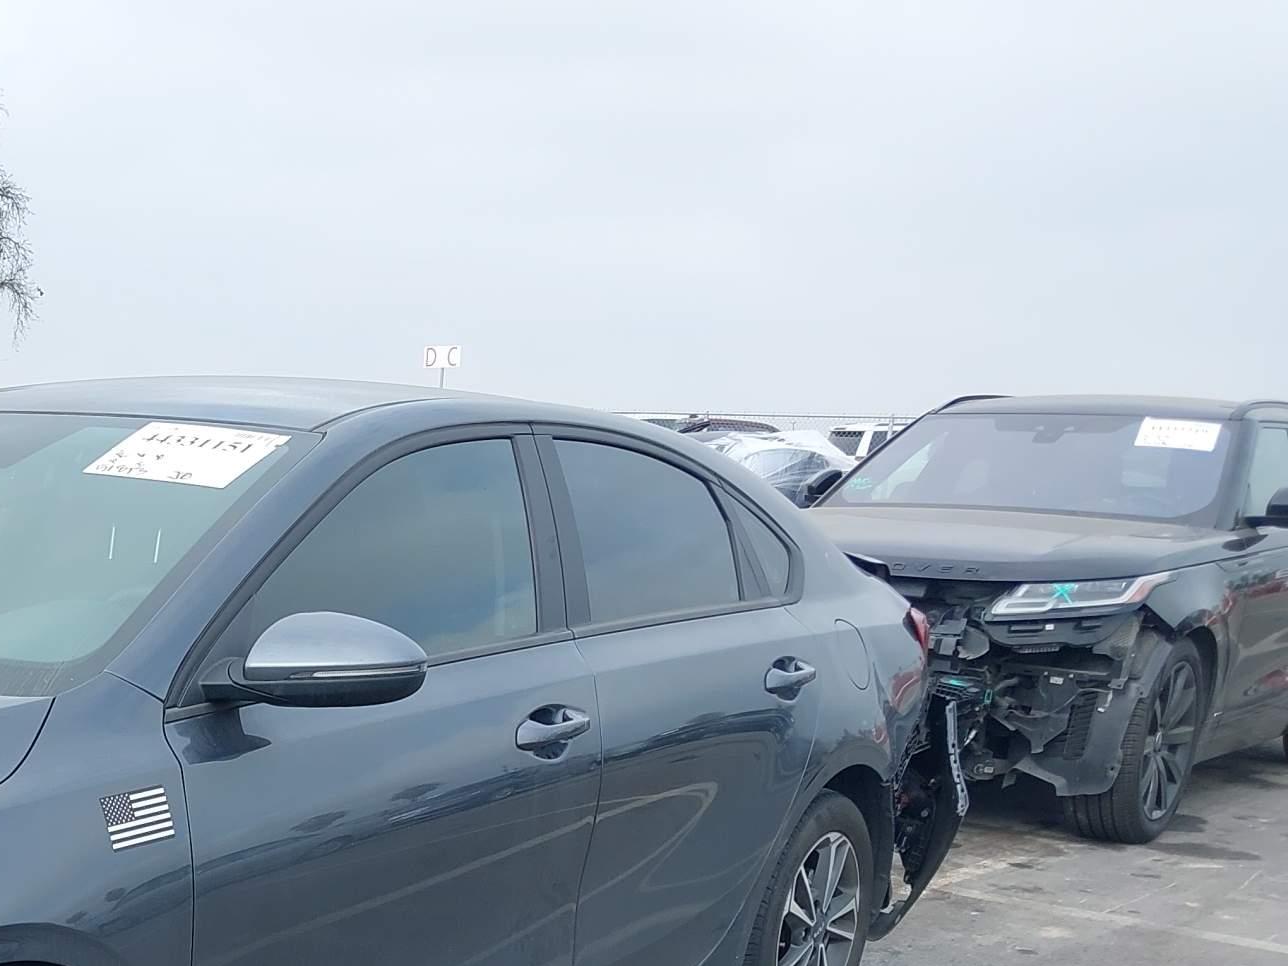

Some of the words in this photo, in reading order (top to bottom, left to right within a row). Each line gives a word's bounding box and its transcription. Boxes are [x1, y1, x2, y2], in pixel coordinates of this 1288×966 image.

[425, 347, 437, 367] D
[447, 346, 458, 367] C
[142, 432, 254, 454] 44331151
[891, 562, 981, 575] OVER
